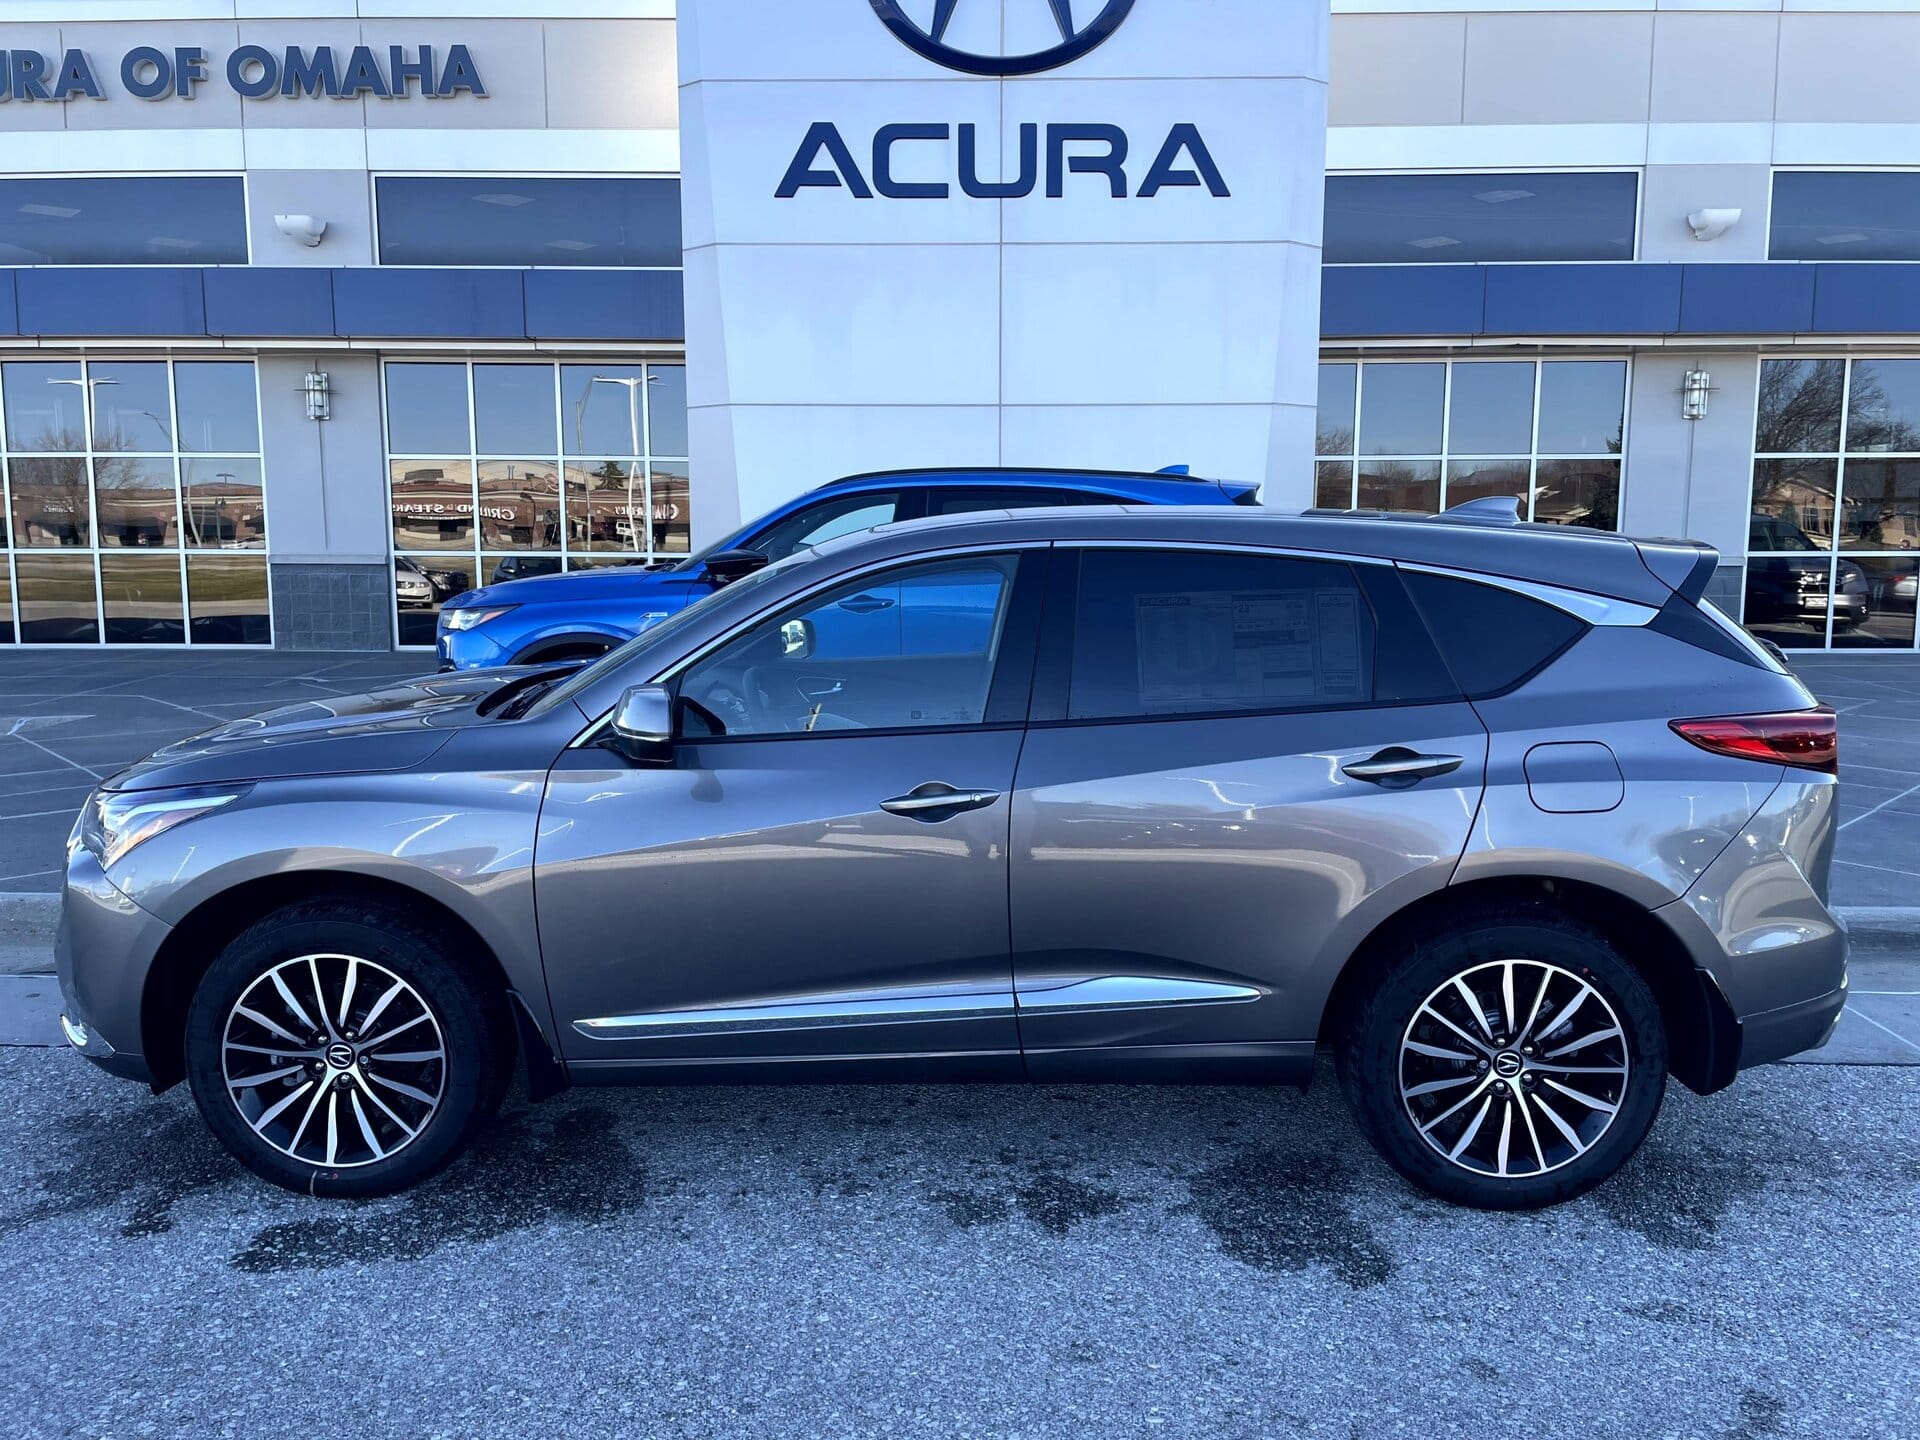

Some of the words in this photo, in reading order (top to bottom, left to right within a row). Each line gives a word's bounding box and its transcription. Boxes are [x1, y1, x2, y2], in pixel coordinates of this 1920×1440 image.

[120, 46, 208, 101] OF
[226, 44, 487, 99] OMAHA
[774, 121, 1231, 199] ACURA
